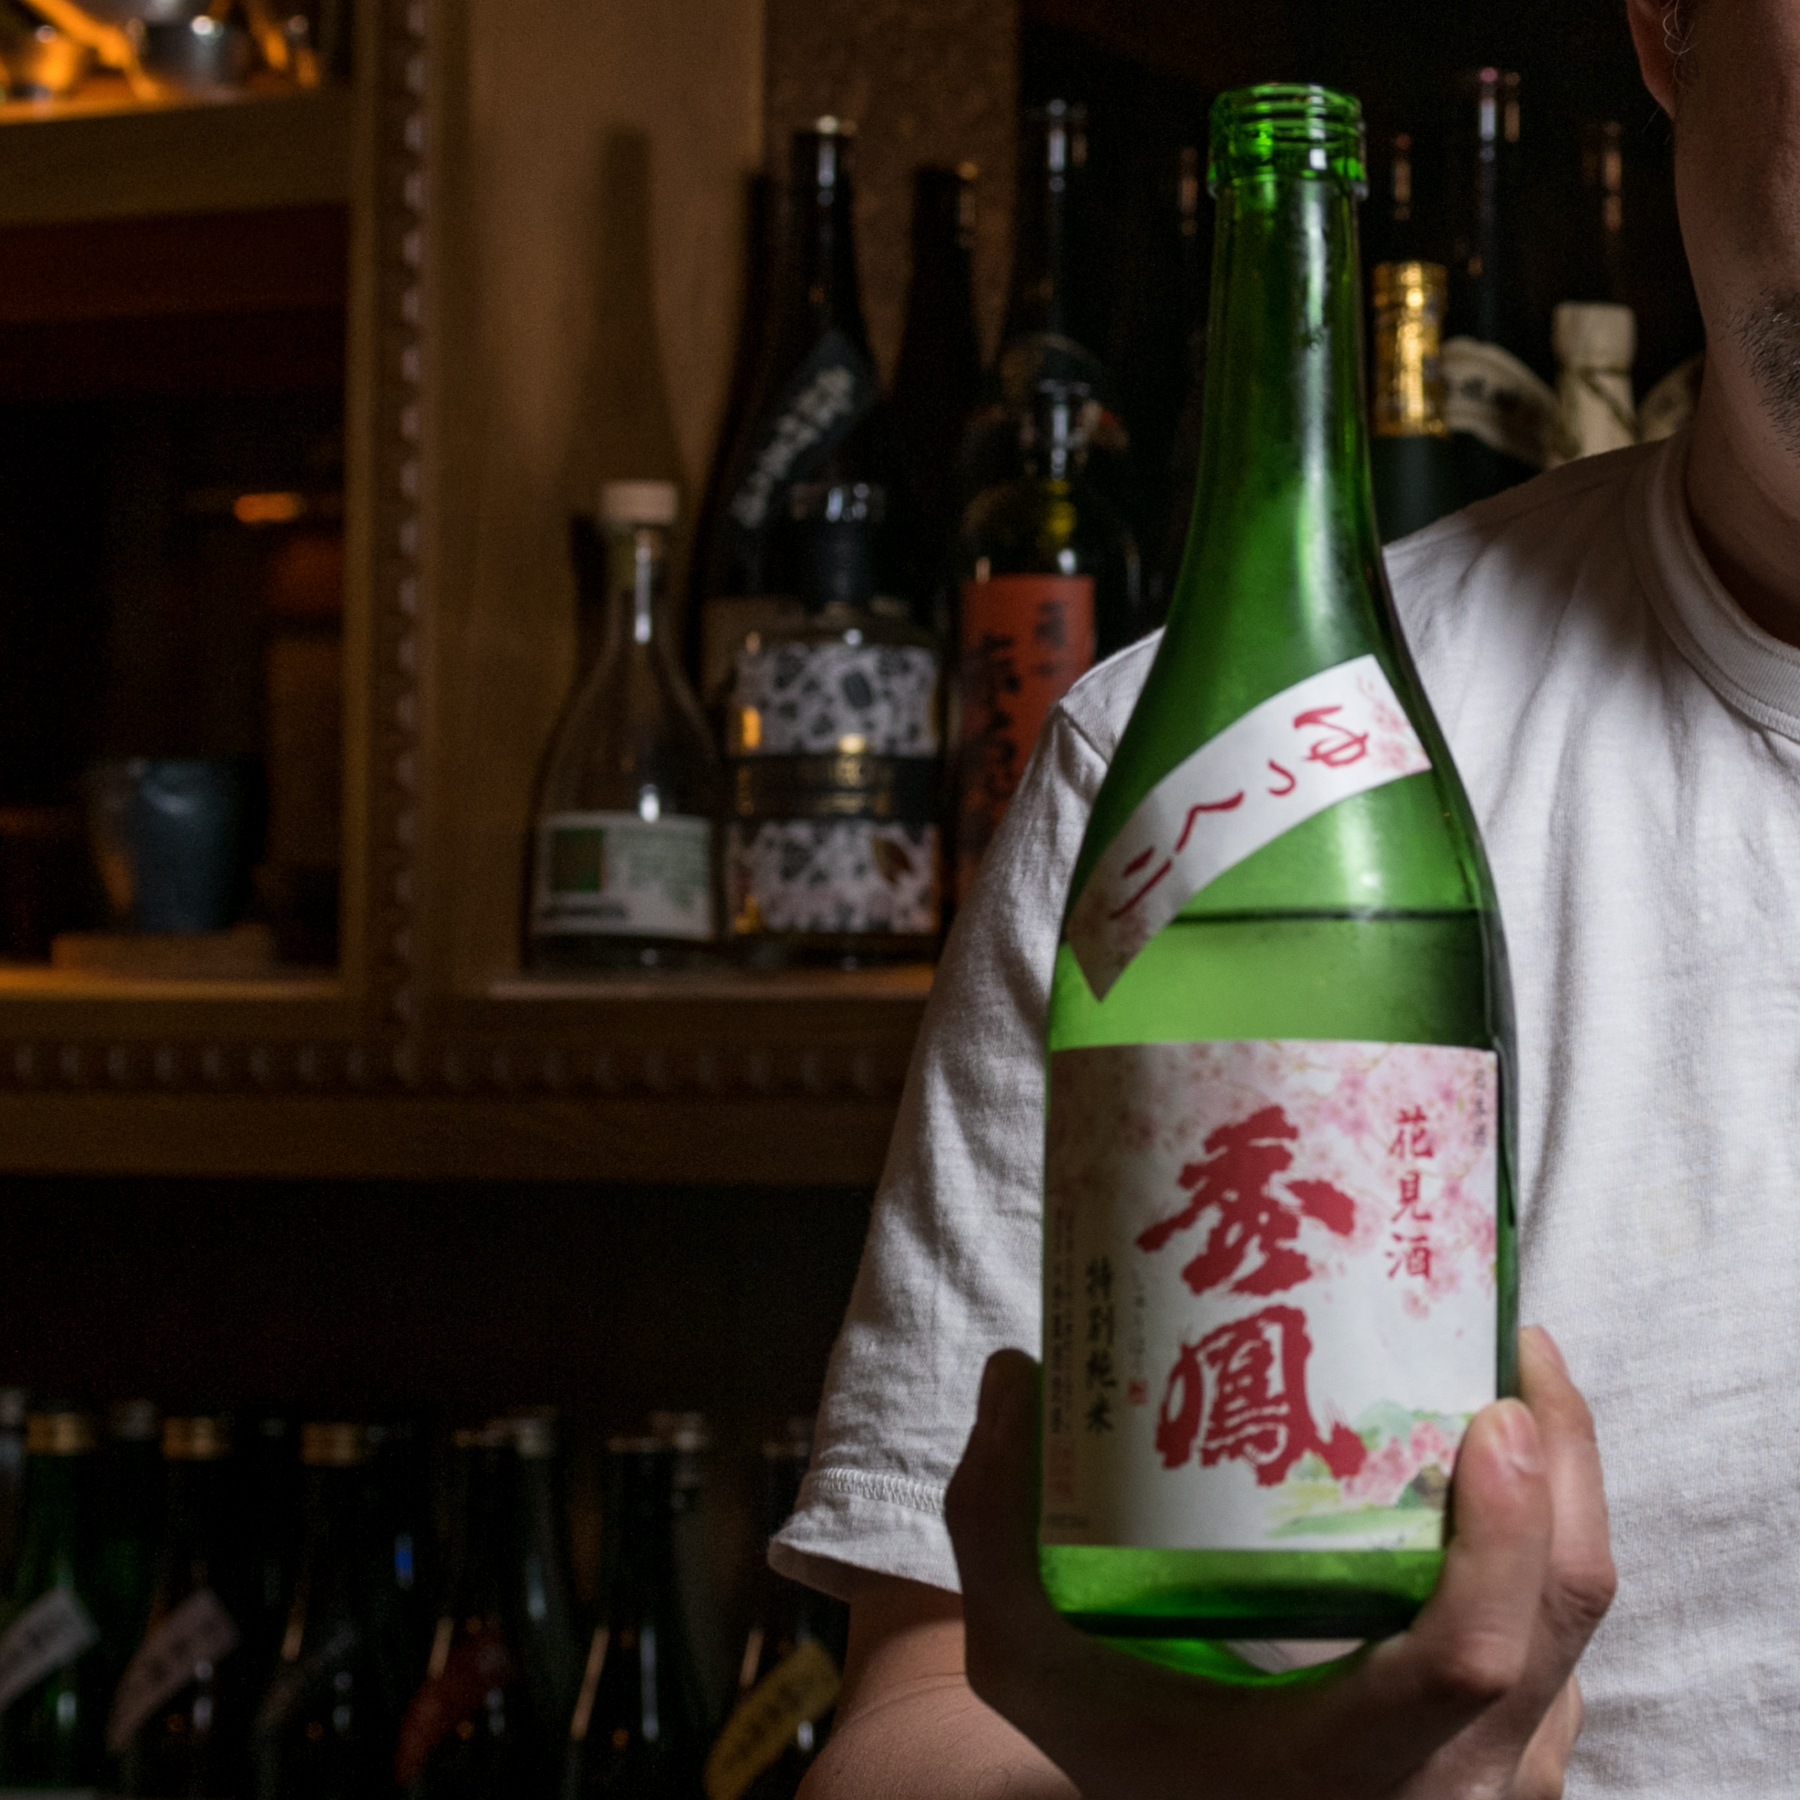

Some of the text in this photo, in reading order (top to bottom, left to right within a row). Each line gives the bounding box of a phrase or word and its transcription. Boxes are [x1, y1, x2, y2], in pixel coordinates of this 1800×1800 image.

[1135, 1104, 1368, 1488] 秀鳳
[1384, 1105, 1434, 1280] 花見酒
